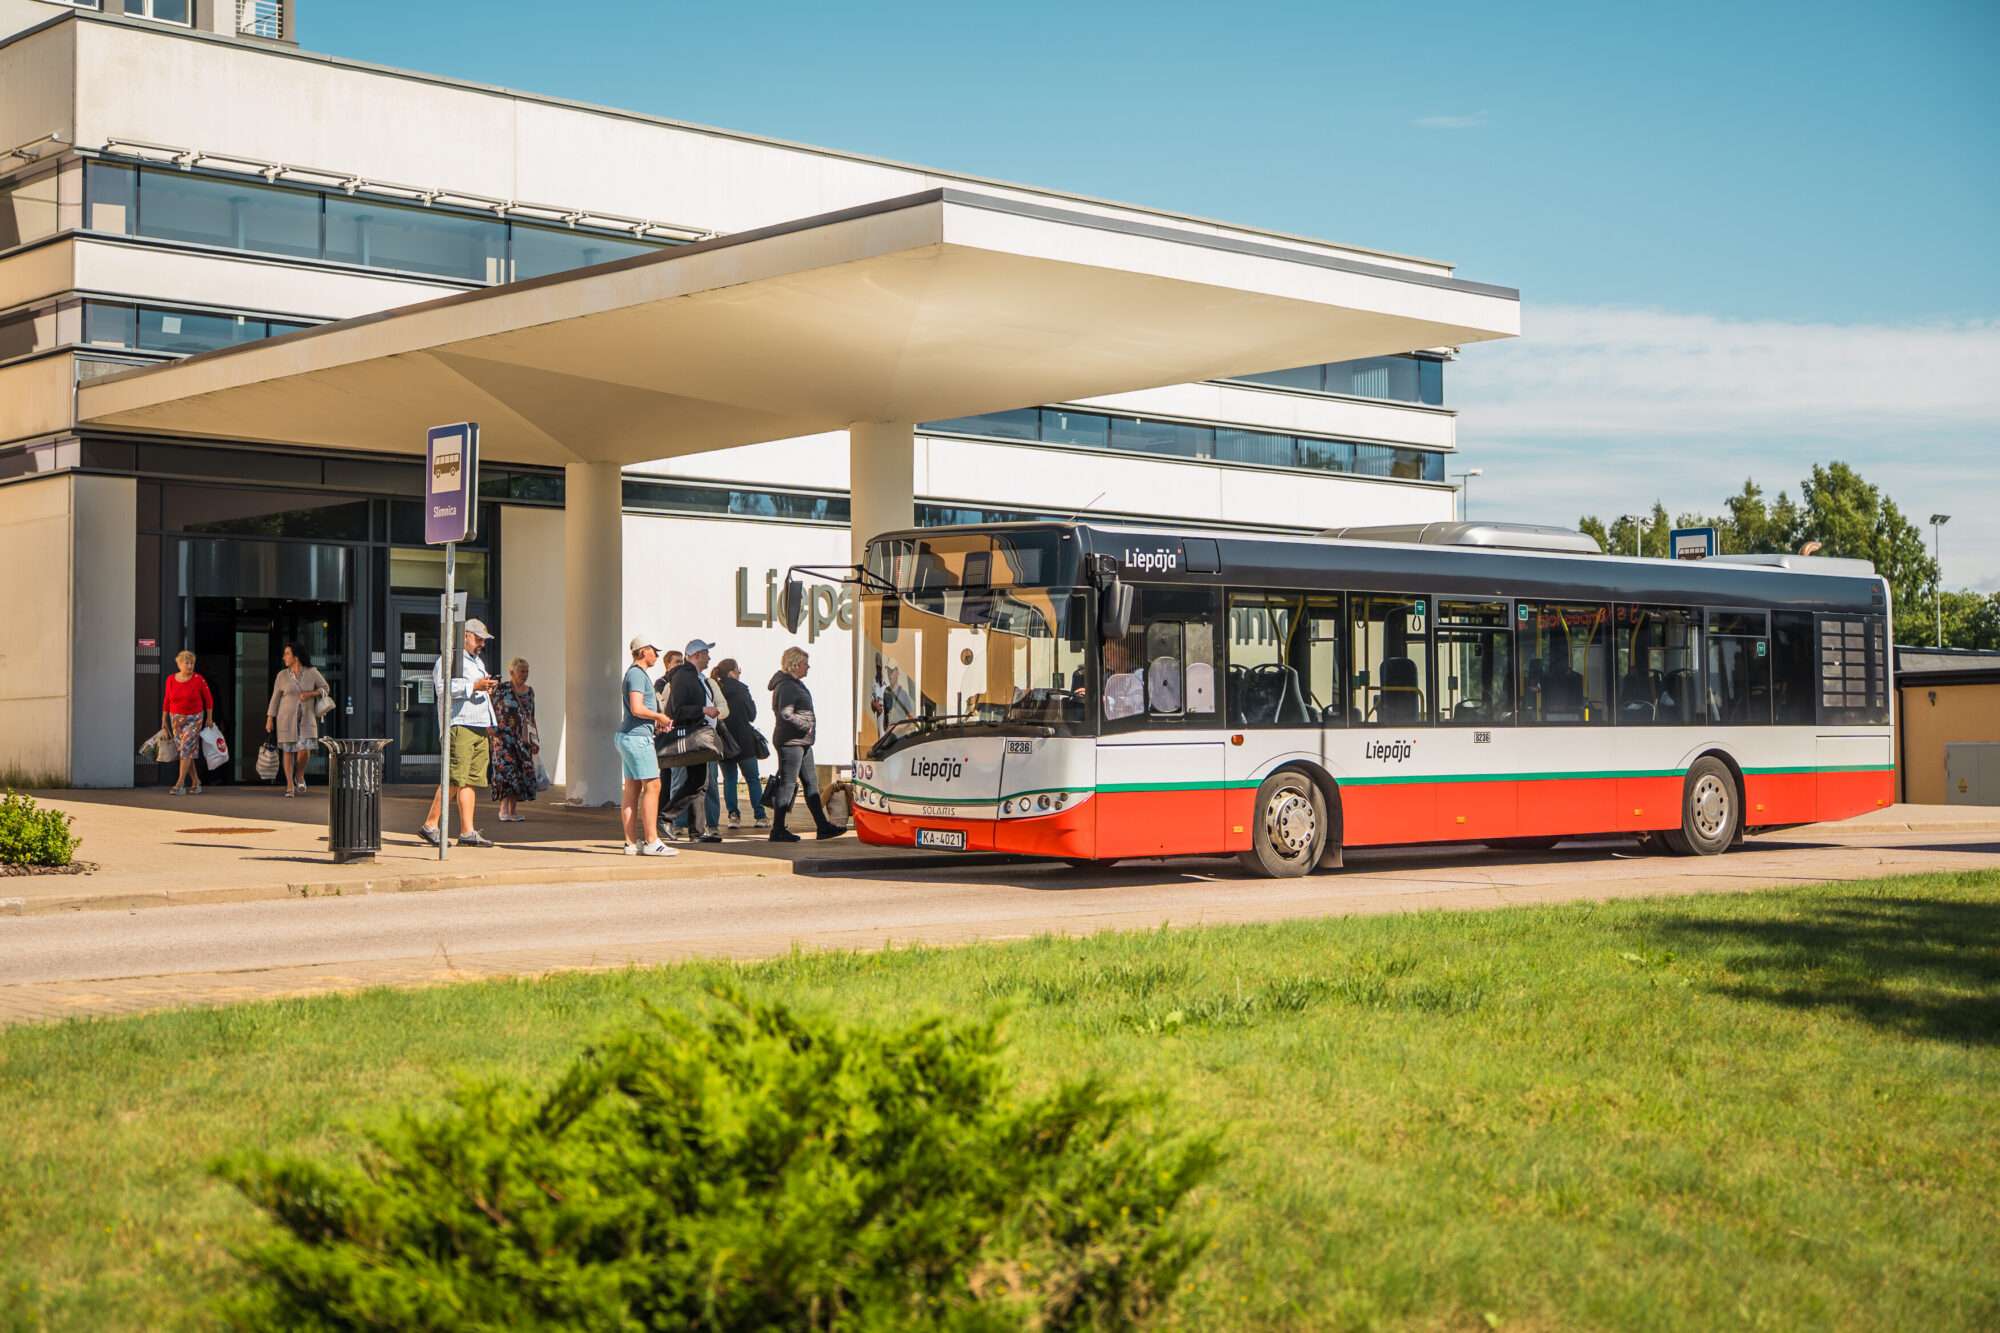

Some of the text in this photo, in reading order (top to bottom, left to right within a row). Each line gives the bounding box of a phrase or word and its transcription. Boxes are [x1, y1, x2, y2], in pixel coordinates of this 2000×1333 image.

[1125, 547, 1177, 573] Liepāja
[1475, 733, 1490, 742] 8236
[1010, 742, 1030, 753] 8236
[1366, 740, 1412, 763] Liepāja
[911, 757, 962, 782] Liepāja
[922, 806, 956, 816] SOLARIS
[923, 831, 961, 846] KA-4021
